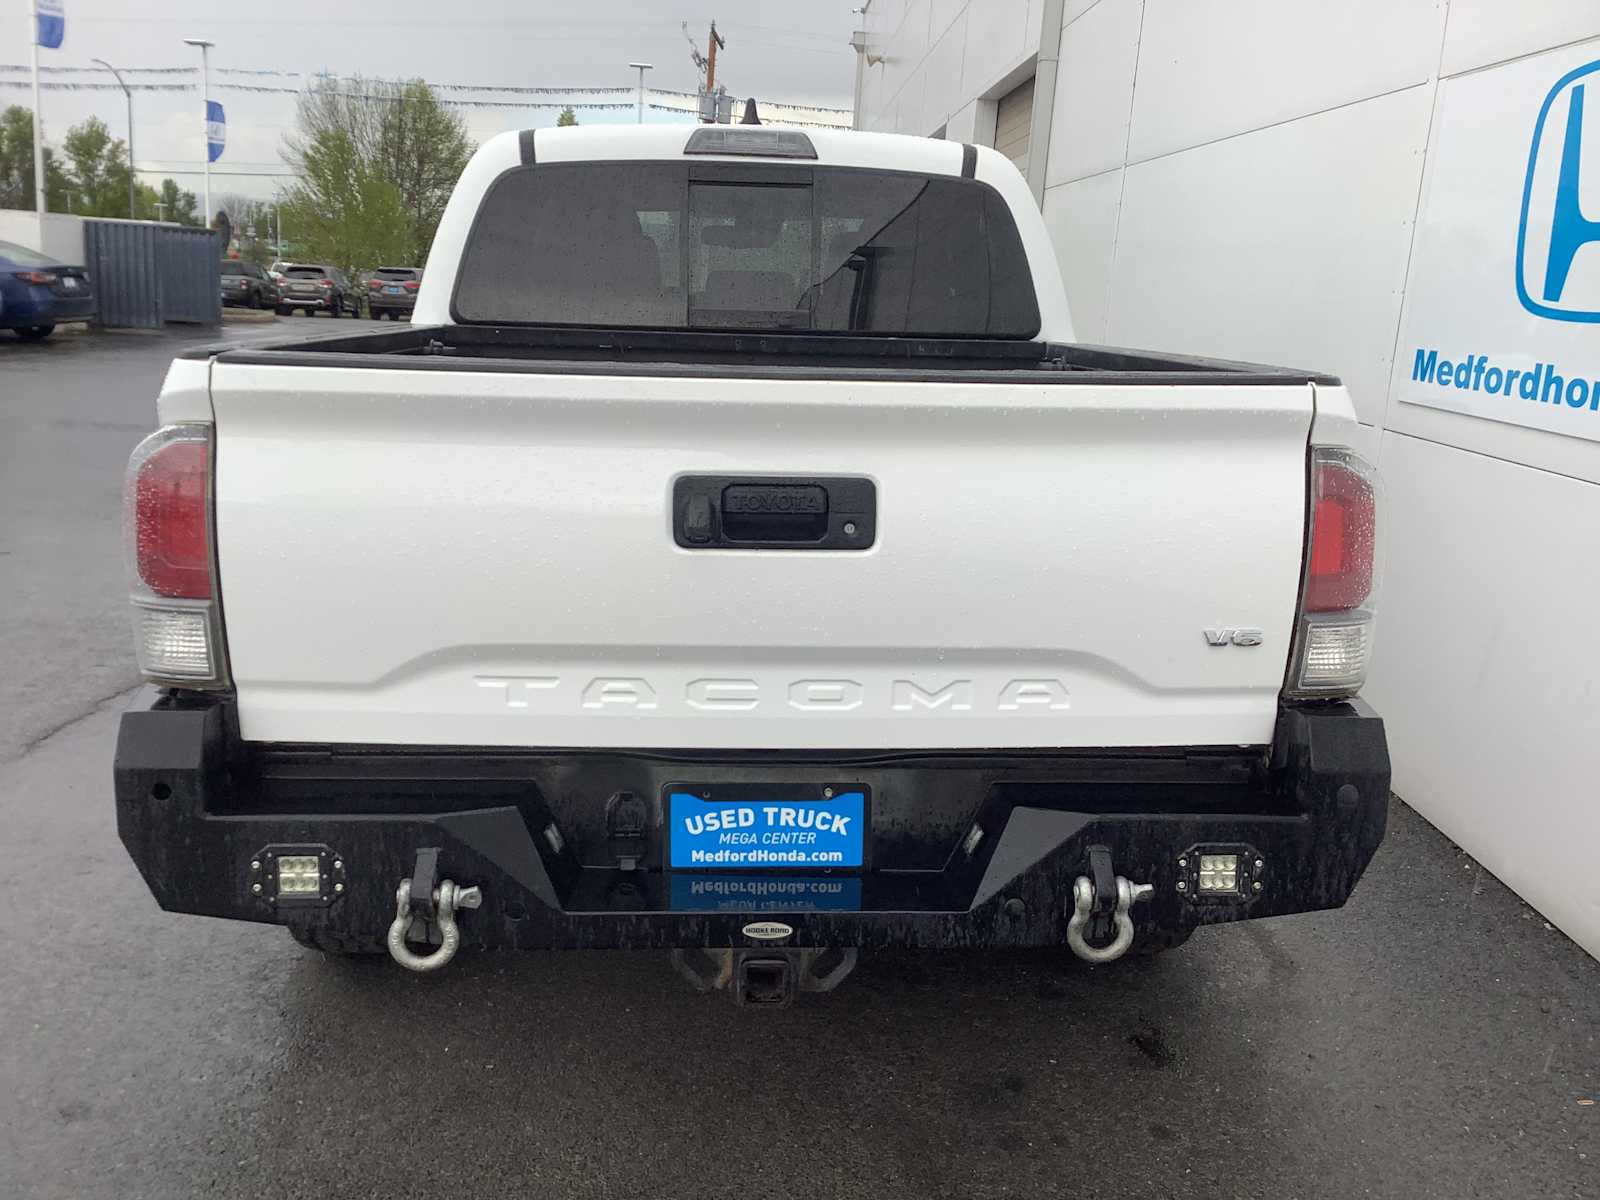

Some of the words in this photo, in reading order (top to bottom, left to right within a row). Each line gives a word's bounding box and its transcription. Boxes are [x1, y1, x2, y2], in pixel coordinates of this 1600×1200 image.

[734, 494, 820, 511] TOYOTA
[1203, 629, 1263, 647] V6
[474, 675, 1071, 711] TACOMA
[685, 808, 754, 836] USED
[763, 807, 851, 836] TRUCK
[719, 832, 758, 845] MEGA
[762, 832, 817, 845] CENTER
[691, 850, 843, 863] MedfordHonda.com
